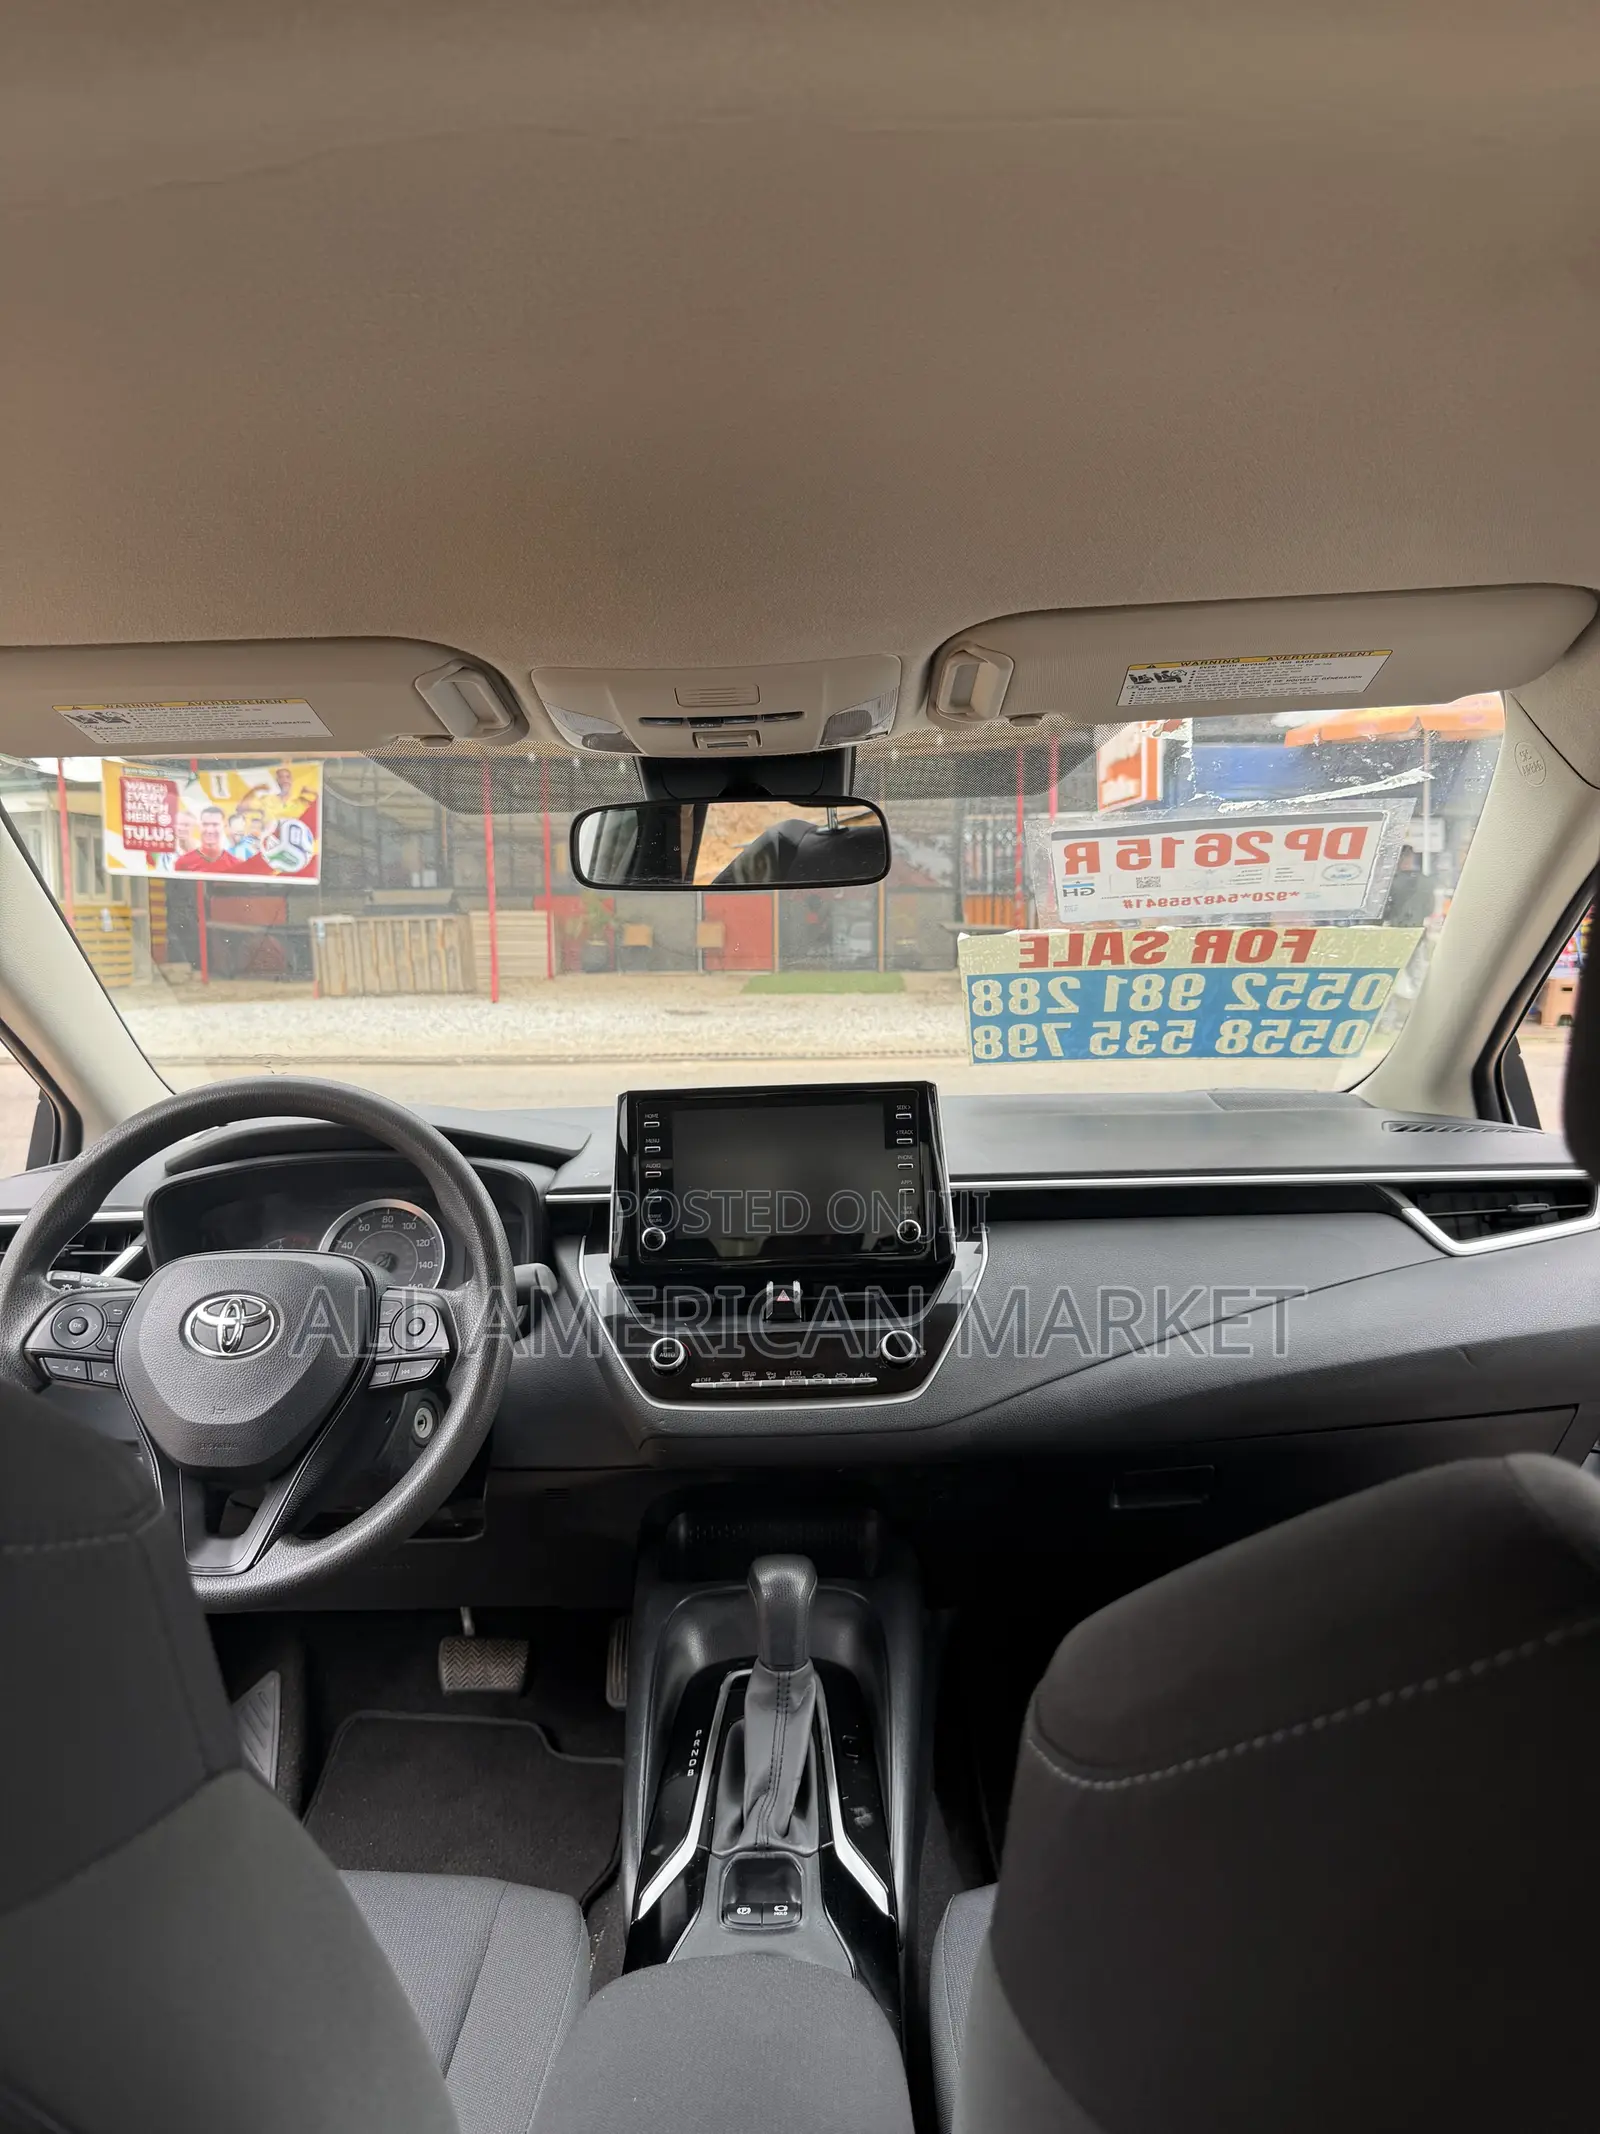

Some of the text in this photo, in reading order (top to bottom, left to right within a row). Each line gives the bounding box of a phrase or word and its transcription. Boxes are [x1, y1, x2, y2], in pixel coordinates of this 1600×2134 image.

[1181, 651, 1377, 667] WARNING AVERTISSEMENT
[382, 1215, 394, 1225] 80
[358, 1223, 370, 1232] 60
[402, 1221, 416, 1230] 100
[341, 1241, 353, 1250] 40
[416, 1238, 430, 1248] 120
[418, 1260, 433, 1270] 140
[694, 1739, 700, 1747] R
[688, 1759, 697, 1767] D
[687, 1769, 694, 1777] B
